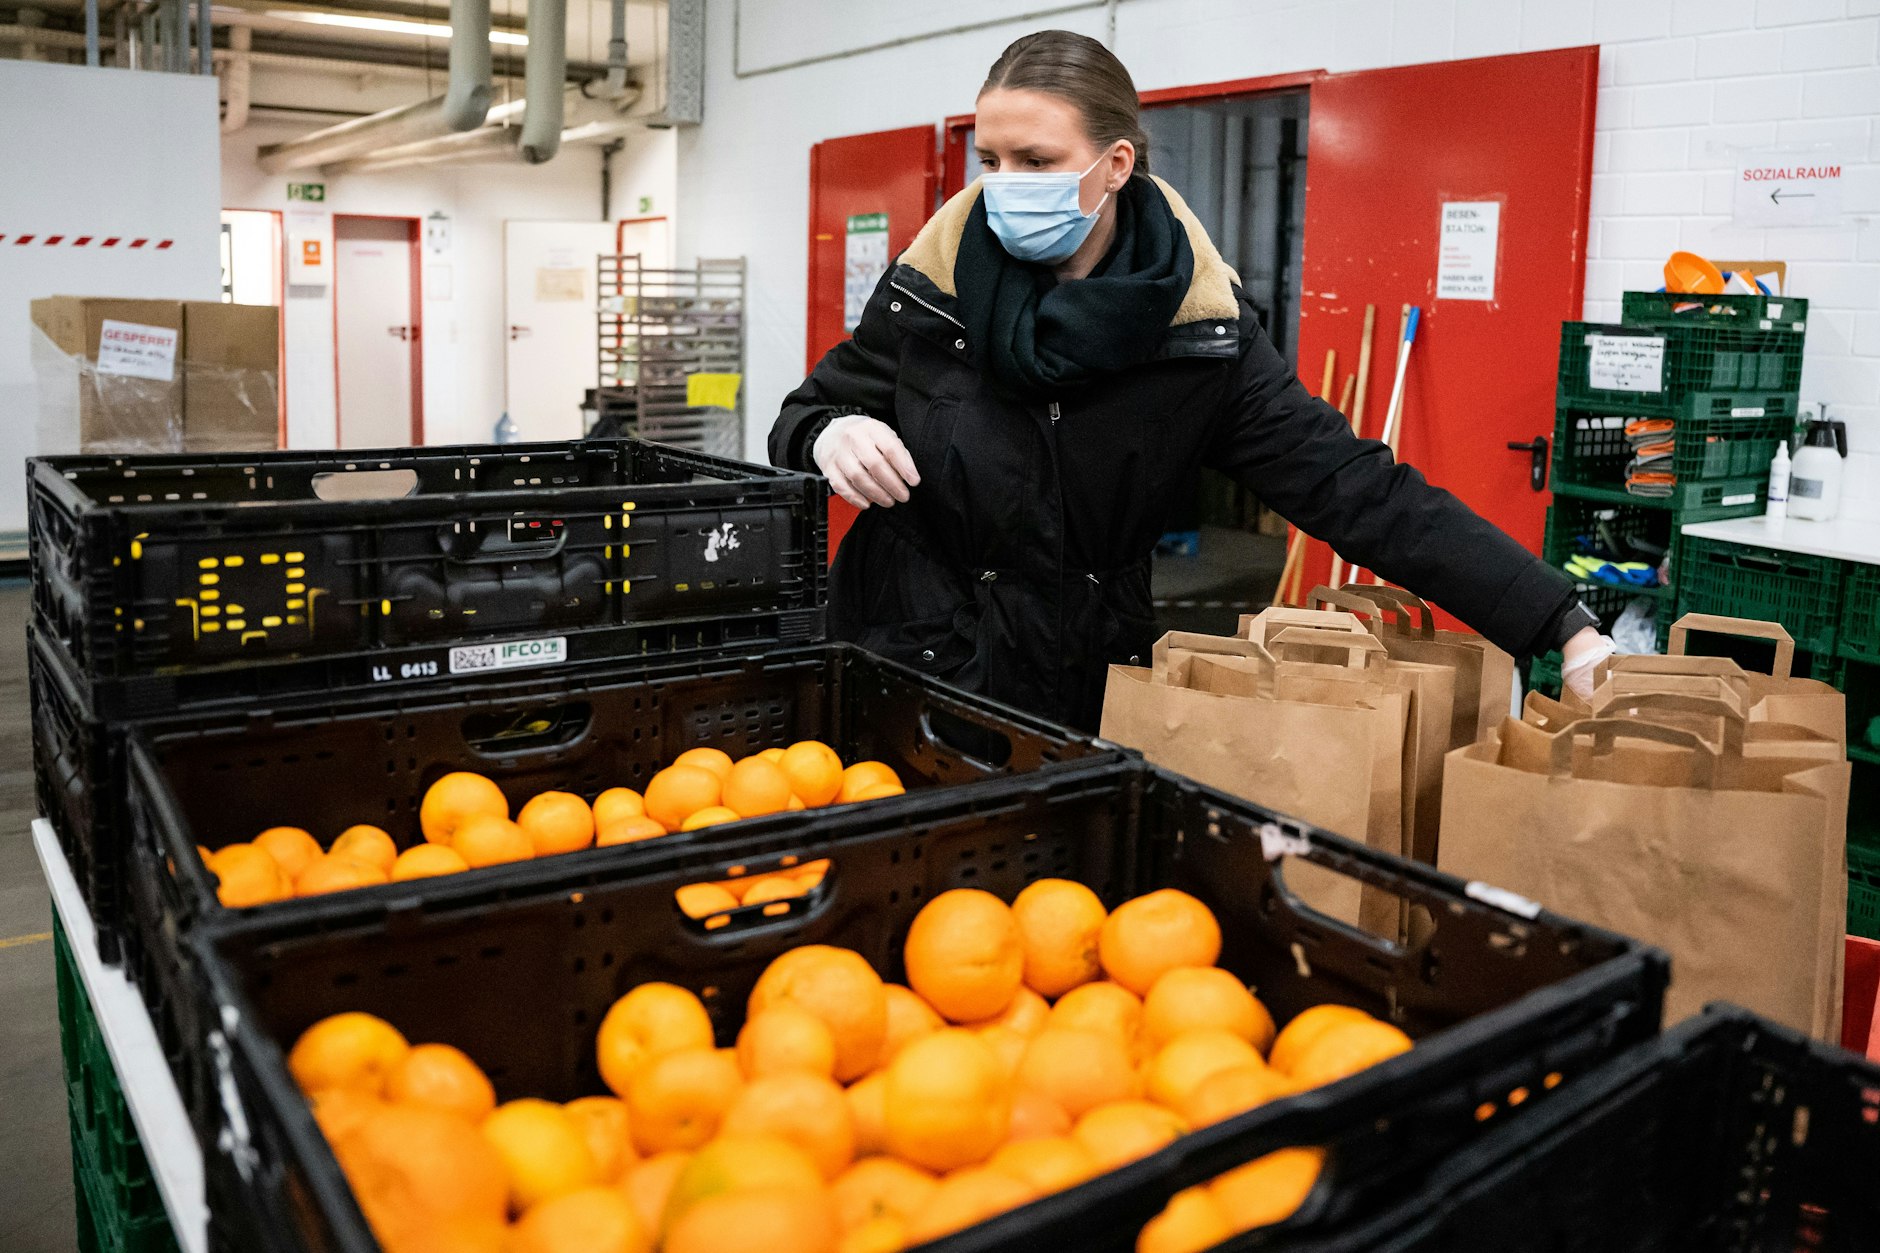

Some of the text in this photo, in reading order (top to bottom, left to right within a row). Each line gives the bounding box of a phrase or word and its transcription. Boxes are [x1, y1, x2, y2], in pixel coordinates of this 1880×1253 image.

[1743, 165, 1841, 181] SOZIALRAUM
[103, 328, 173, 347] GESPERRT
[502, 642, 542, 658] IFCO
[372, 660, 438, 682] LL 6413
